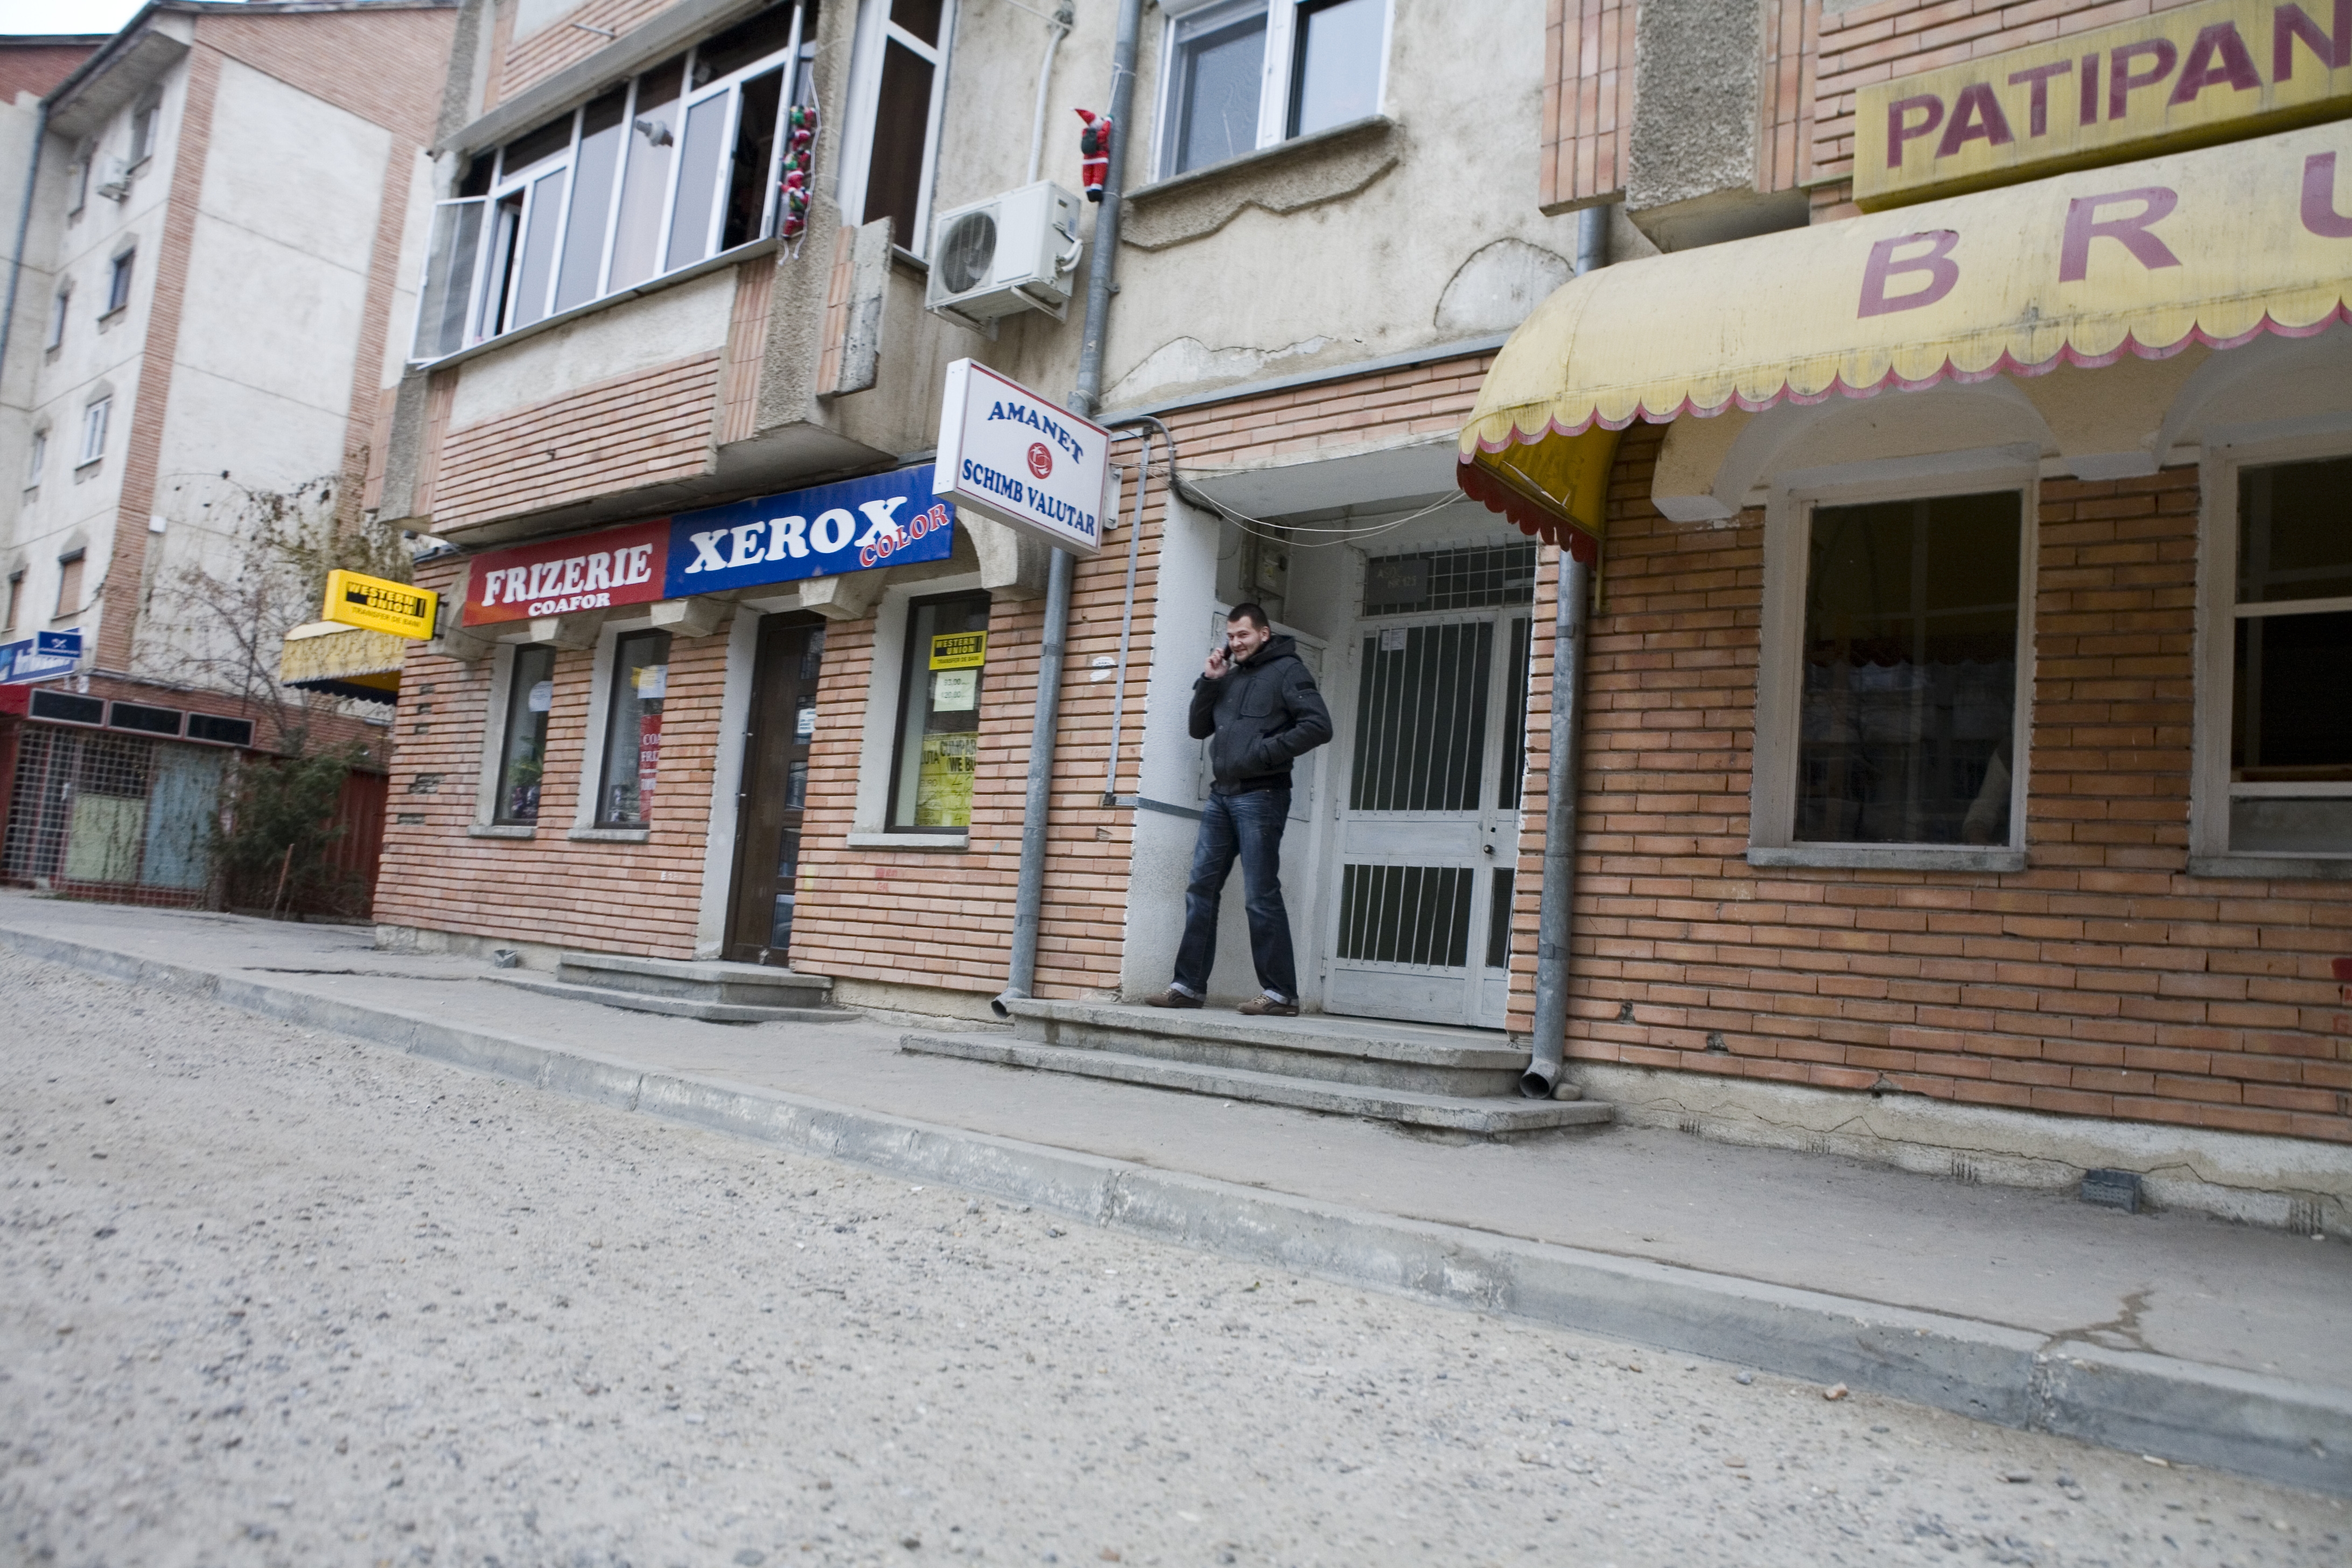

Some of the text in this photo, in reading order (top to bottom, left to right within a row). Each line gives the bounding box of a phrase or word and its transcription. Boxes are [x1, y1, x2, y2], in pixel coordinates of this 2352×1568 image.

[988, 401, 1083, 464] AMANET
[962, 459, 1095, 536] SCHIMB VALUTAR
[685, 496, 907, 573] XEROX
[859, 503, 950, 568] COLOR
[481, 543, 653, 606] FRIZERIE
[348, 582, 415, 605] WESTERN
[367, 596, 415, 615] UNION
[528, 592, 611, 617] COAFOR
[352, 606, 389, 619] TRANSFER
[936, 637, 975, 648] WESTERN
[947, 645, 975, 655] UNION
